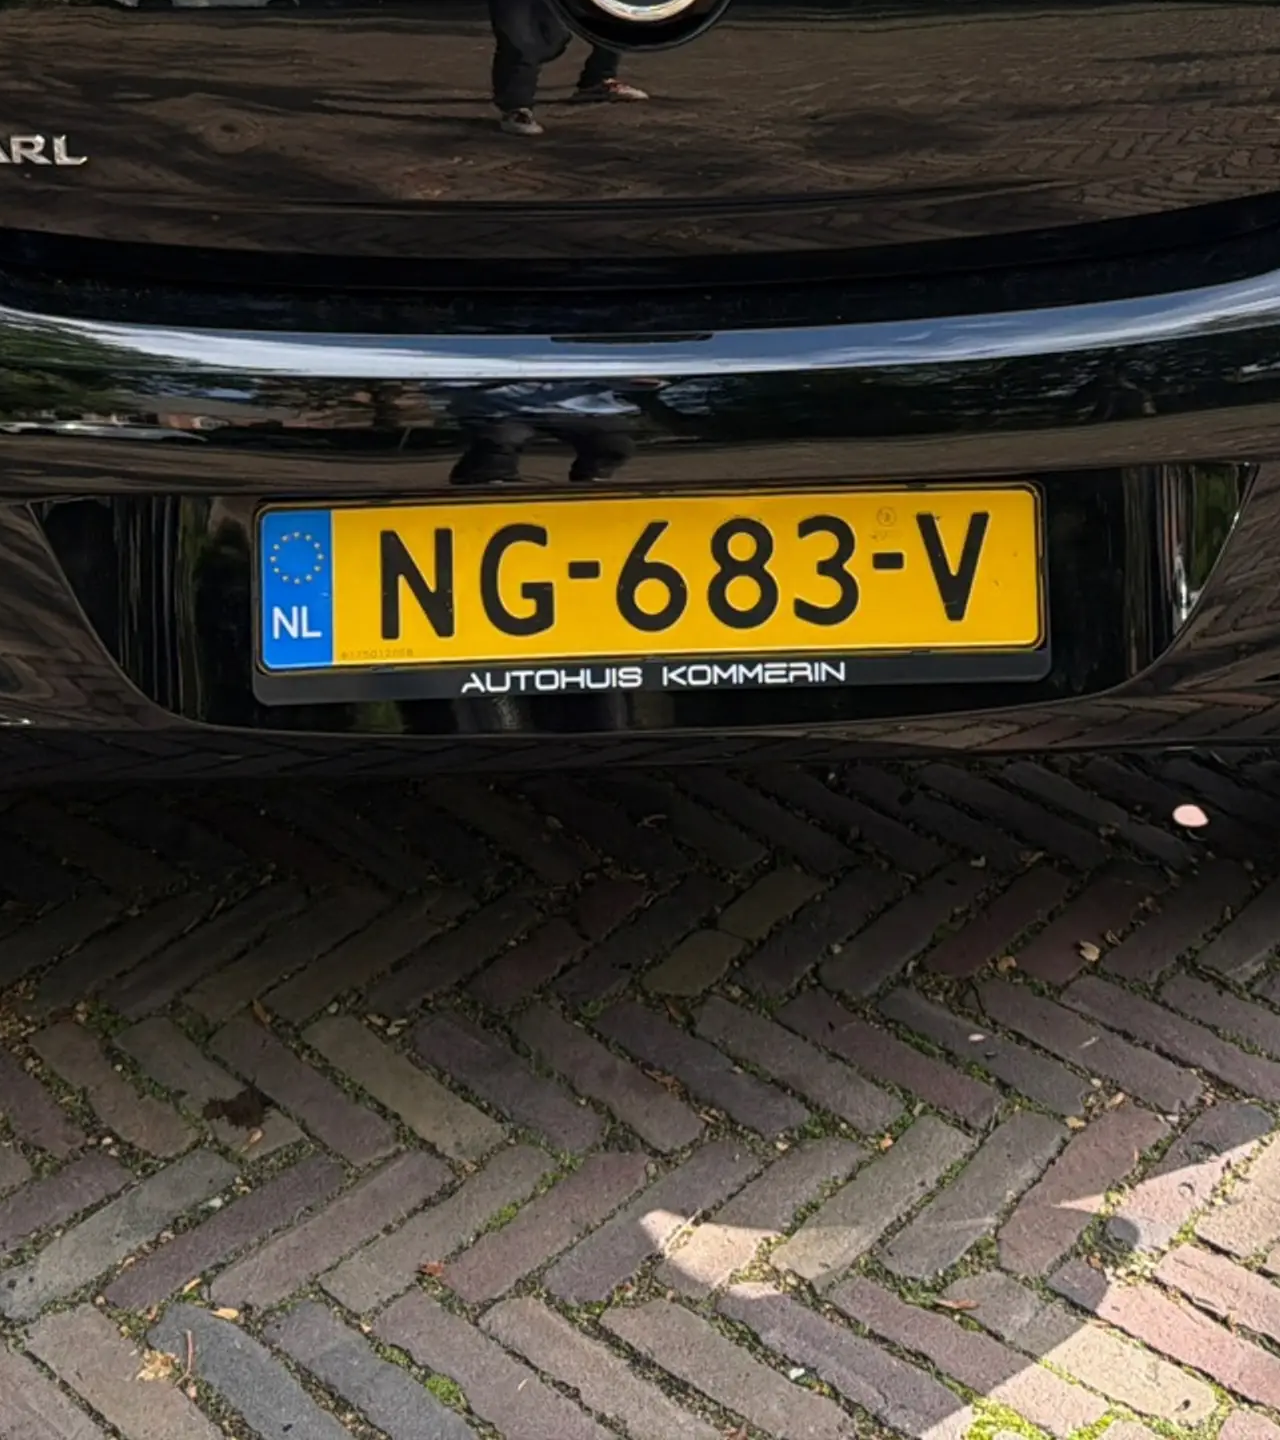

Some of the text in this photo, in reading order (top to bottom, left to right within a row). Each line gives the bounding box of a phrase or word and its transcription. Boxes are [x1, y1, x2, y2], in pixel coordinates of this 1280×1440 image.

[379, 511, 989, 640] NG-683-V
[272, 606, 322, 640] NL
[461, 661, 846, 694] AUTOHUIS KOMMERIN
